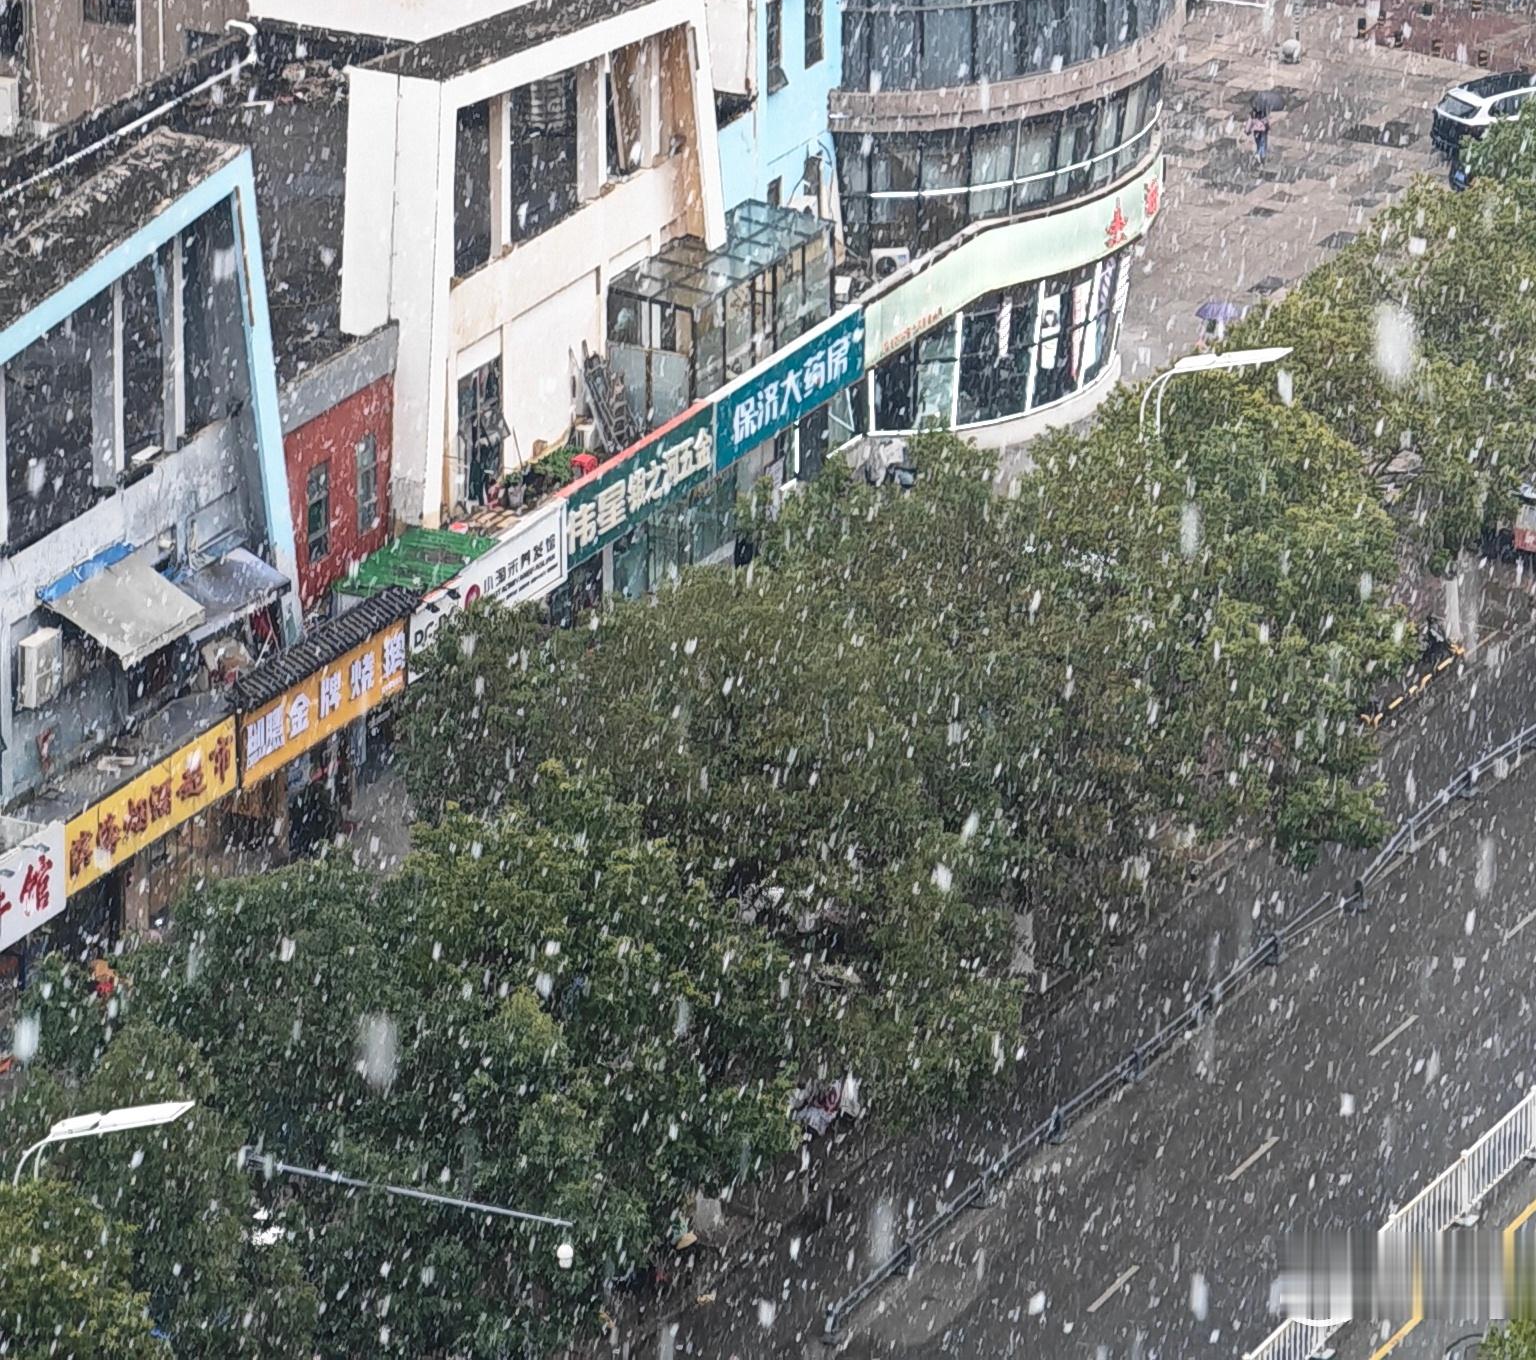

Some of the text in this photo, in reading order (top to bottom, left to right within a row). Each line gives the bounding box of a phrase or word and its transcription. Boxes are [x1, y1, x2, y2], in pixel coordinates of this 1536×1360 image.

[733, 334, 850, 445] 保济大药房
